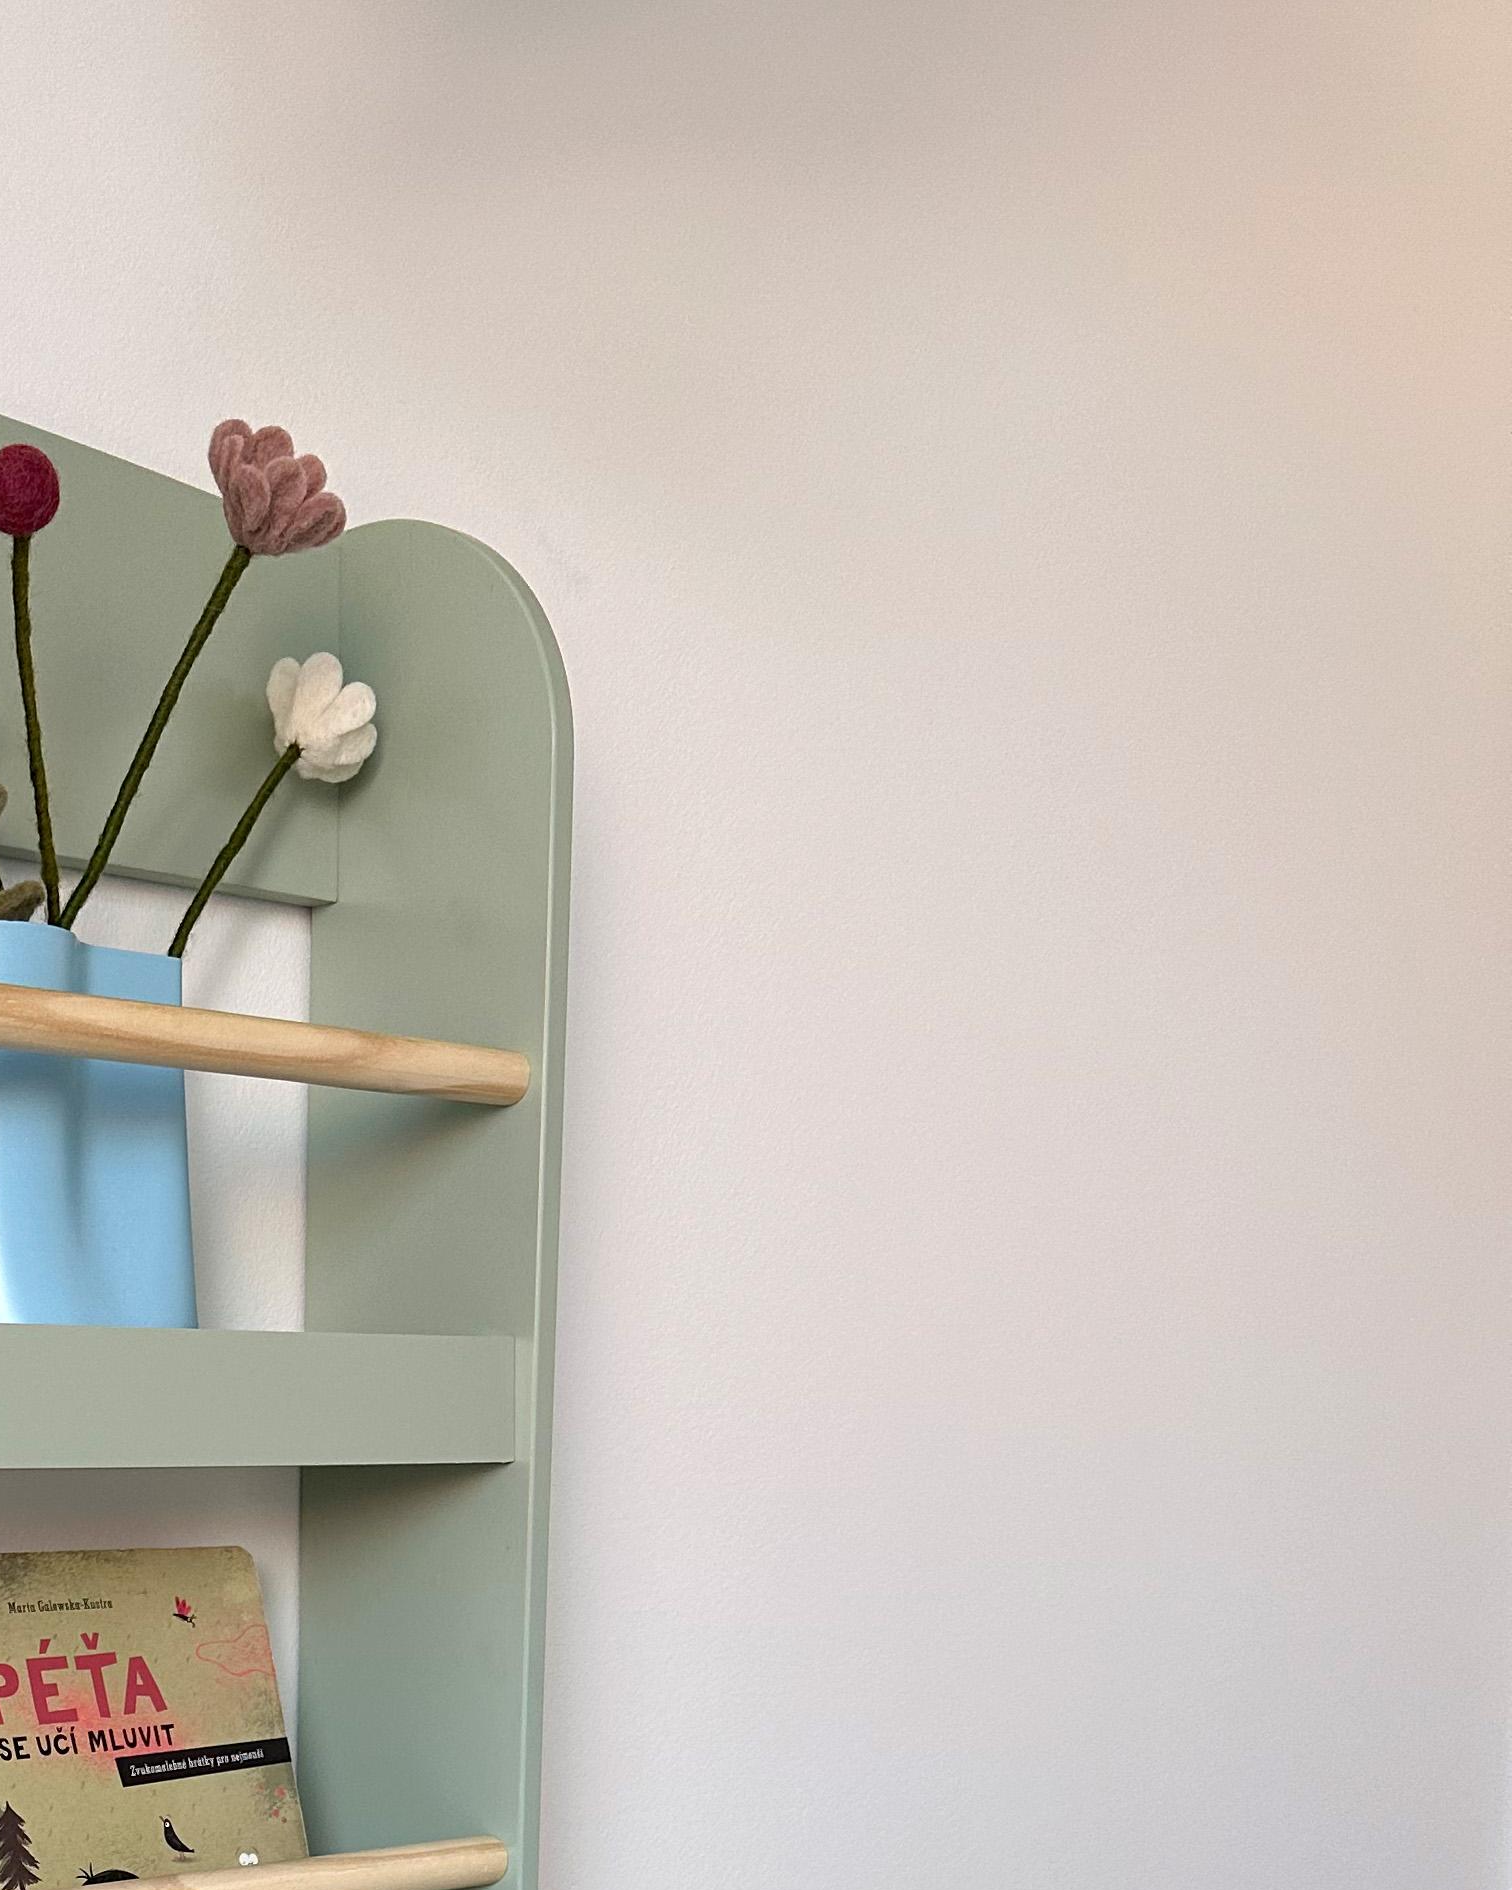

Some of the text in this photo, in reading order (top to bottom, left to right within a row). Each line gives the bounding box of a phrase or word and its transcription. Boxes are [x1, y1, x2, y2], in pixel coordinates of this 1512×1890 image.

[35, 1726, 79, 1756] UČÍ
[87, 1724, 175, 1753] MLUVIT
[216, 1753, 230, 1766] pro
